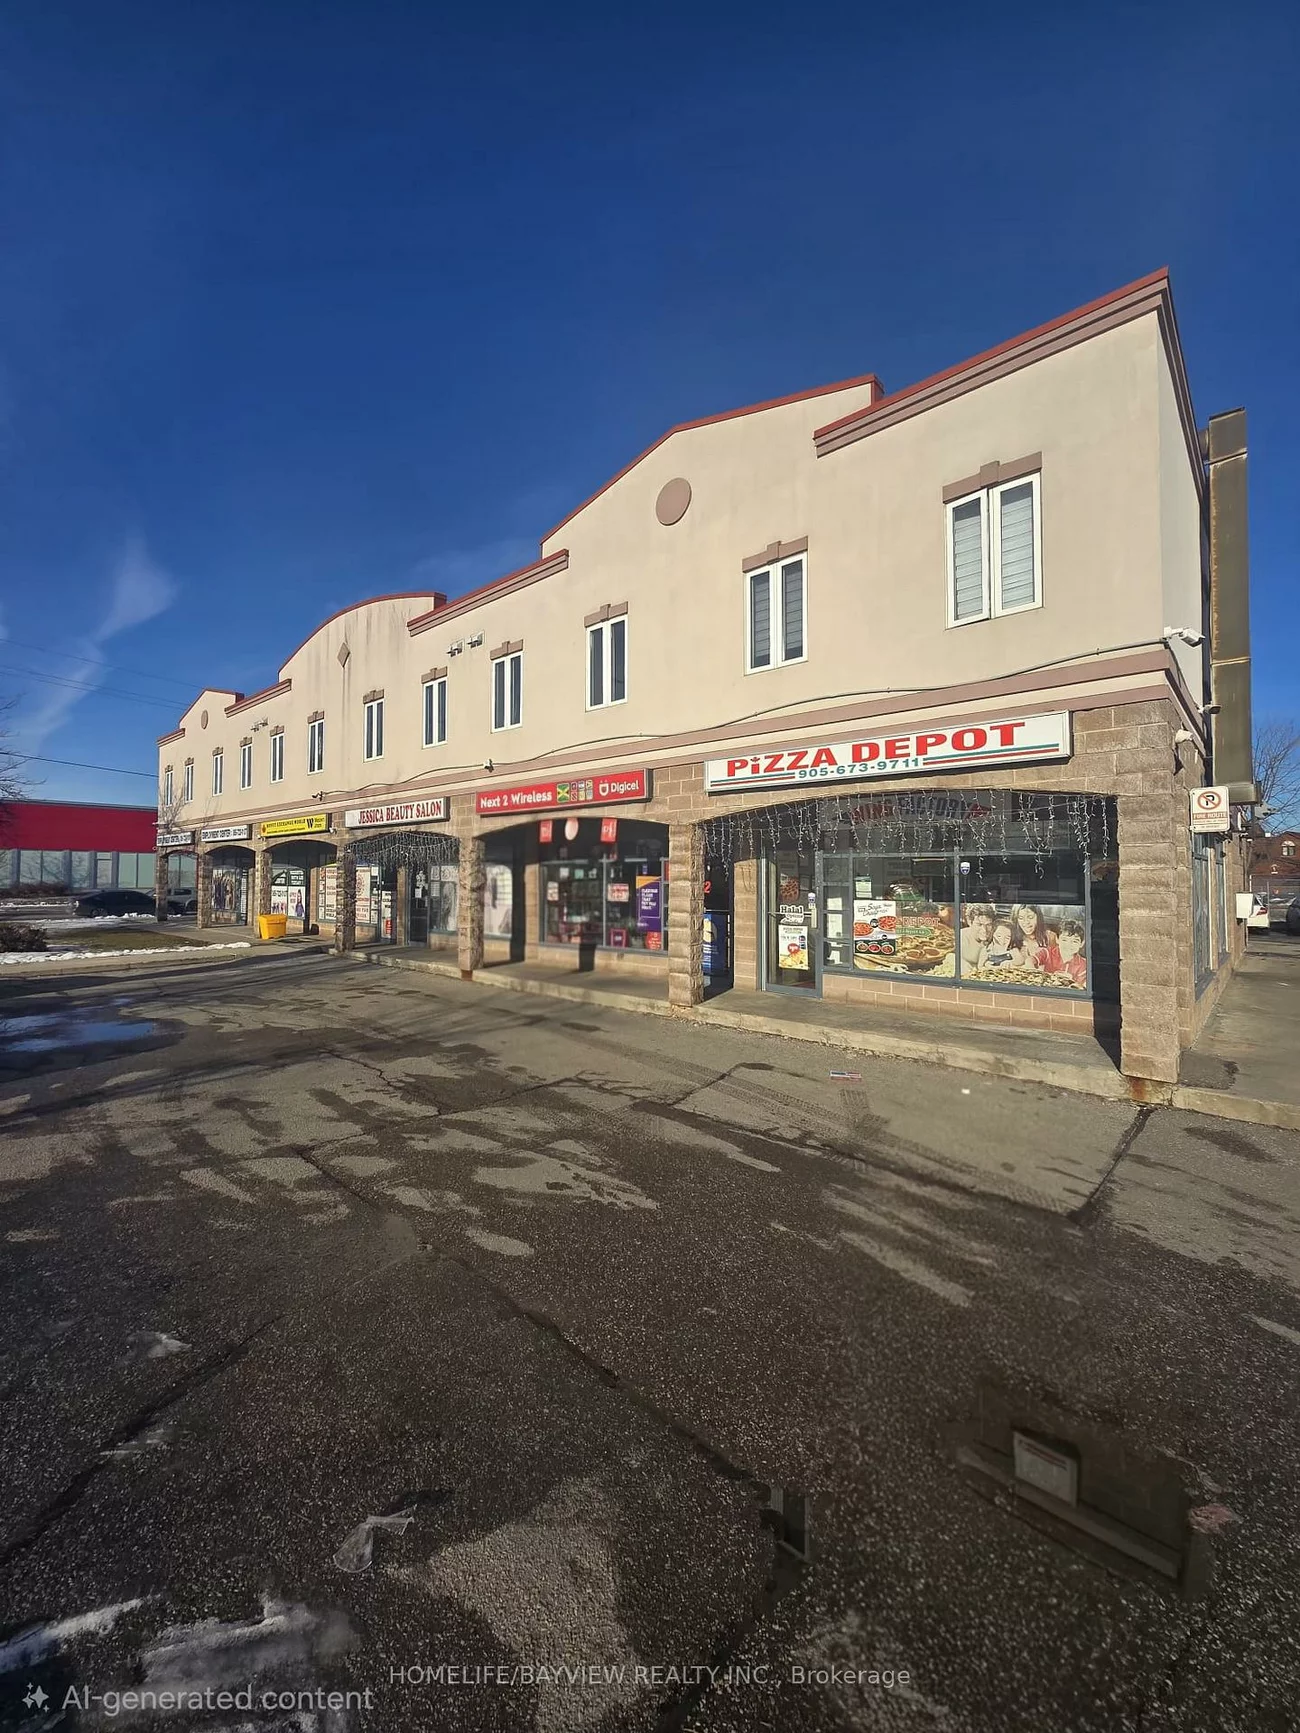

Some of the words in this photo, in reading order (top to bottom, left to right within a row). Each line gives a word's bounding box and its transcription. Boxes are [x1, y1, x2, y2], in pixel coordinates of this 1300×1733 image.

[852, 722, 1025, 764] DEPOT
[798, 757, 920, 779] 905-673-9711
[610, 780, 639, 794] Digicel
[480, 797, 501, 808] Next
[502, 795, 508, 806] 2
[511, 790, 552, 806] Wireless
[358, 809, 384, 824] JESSICA
[386, 804, 415, 821] BEAUTY
[416, 801, 442, 818] SALON
[781, 906, 803, 914] Halal
[902, 916, 940, 926] DEPOT
